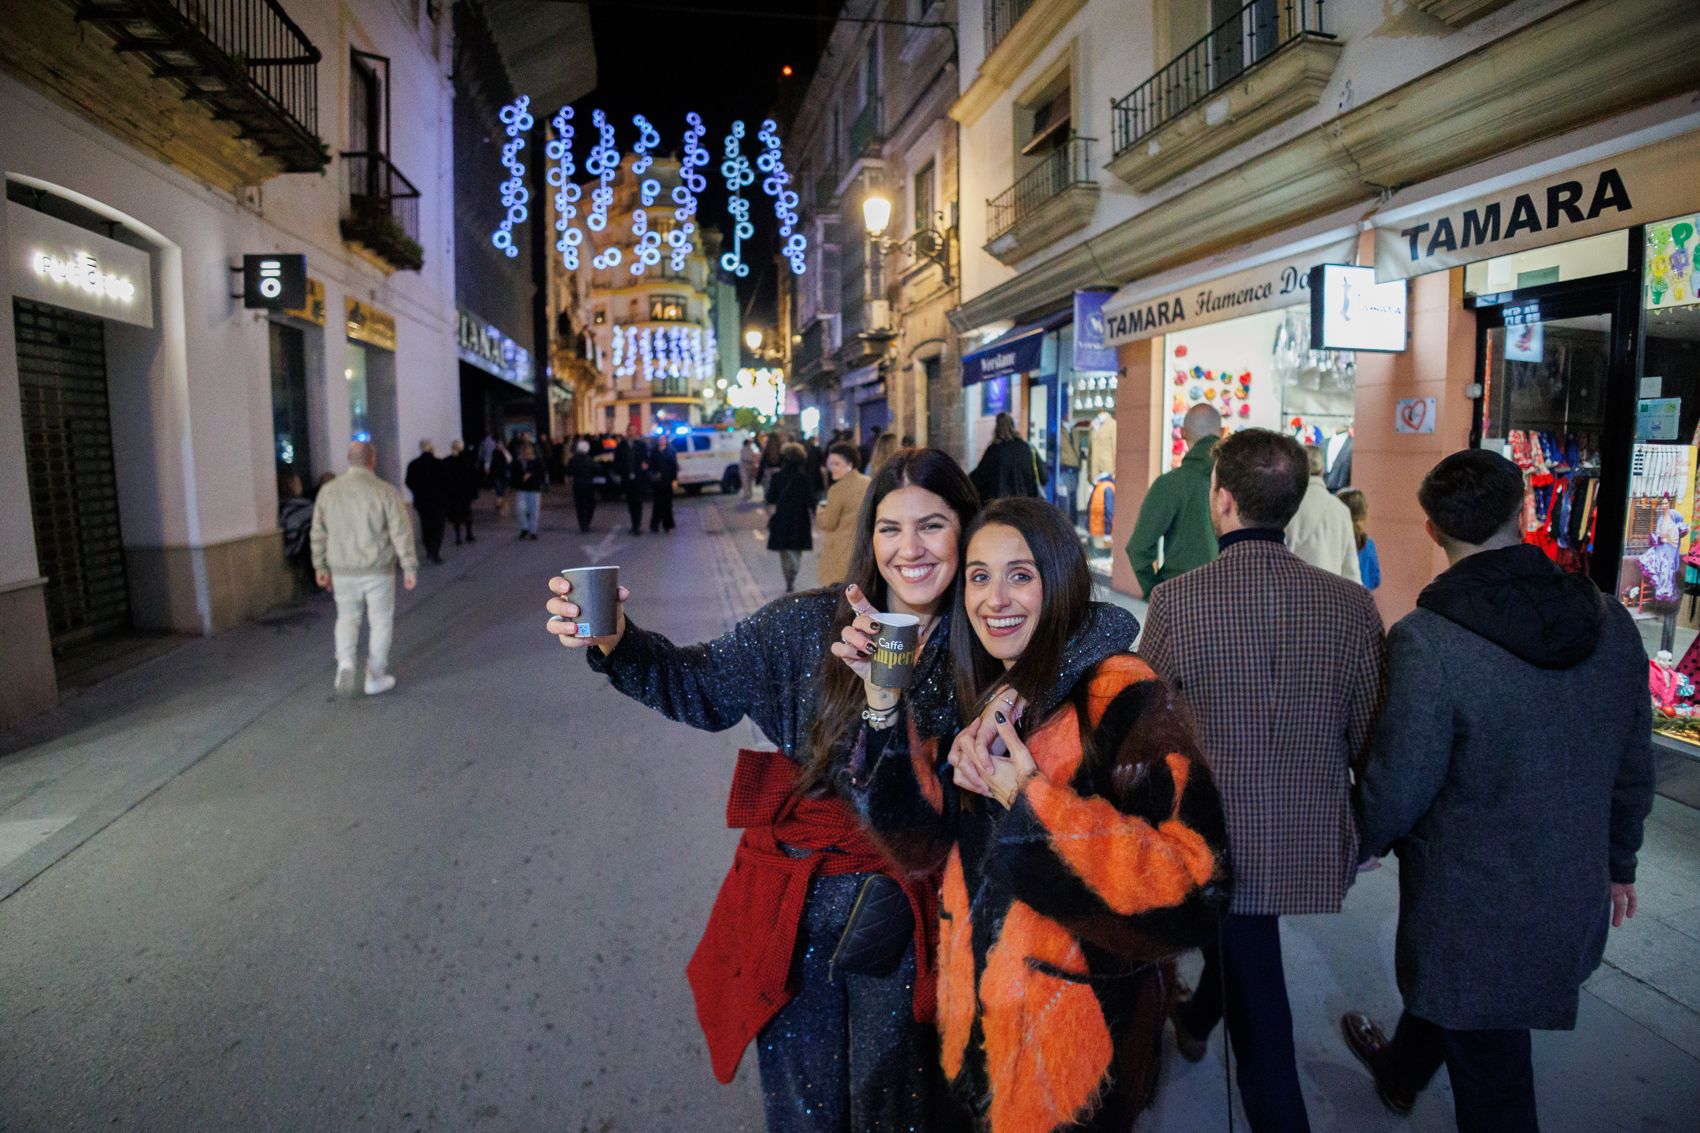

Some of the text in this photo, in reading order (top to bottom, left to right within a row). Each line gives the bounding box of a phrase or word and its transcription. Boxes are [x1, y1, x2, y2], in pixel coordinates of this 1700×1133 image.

[1401, 168, 1633, 262] TAMARA
[1107, 298, 1185, 339] TAMARA
[878, 637, 904, 651] Caffè
